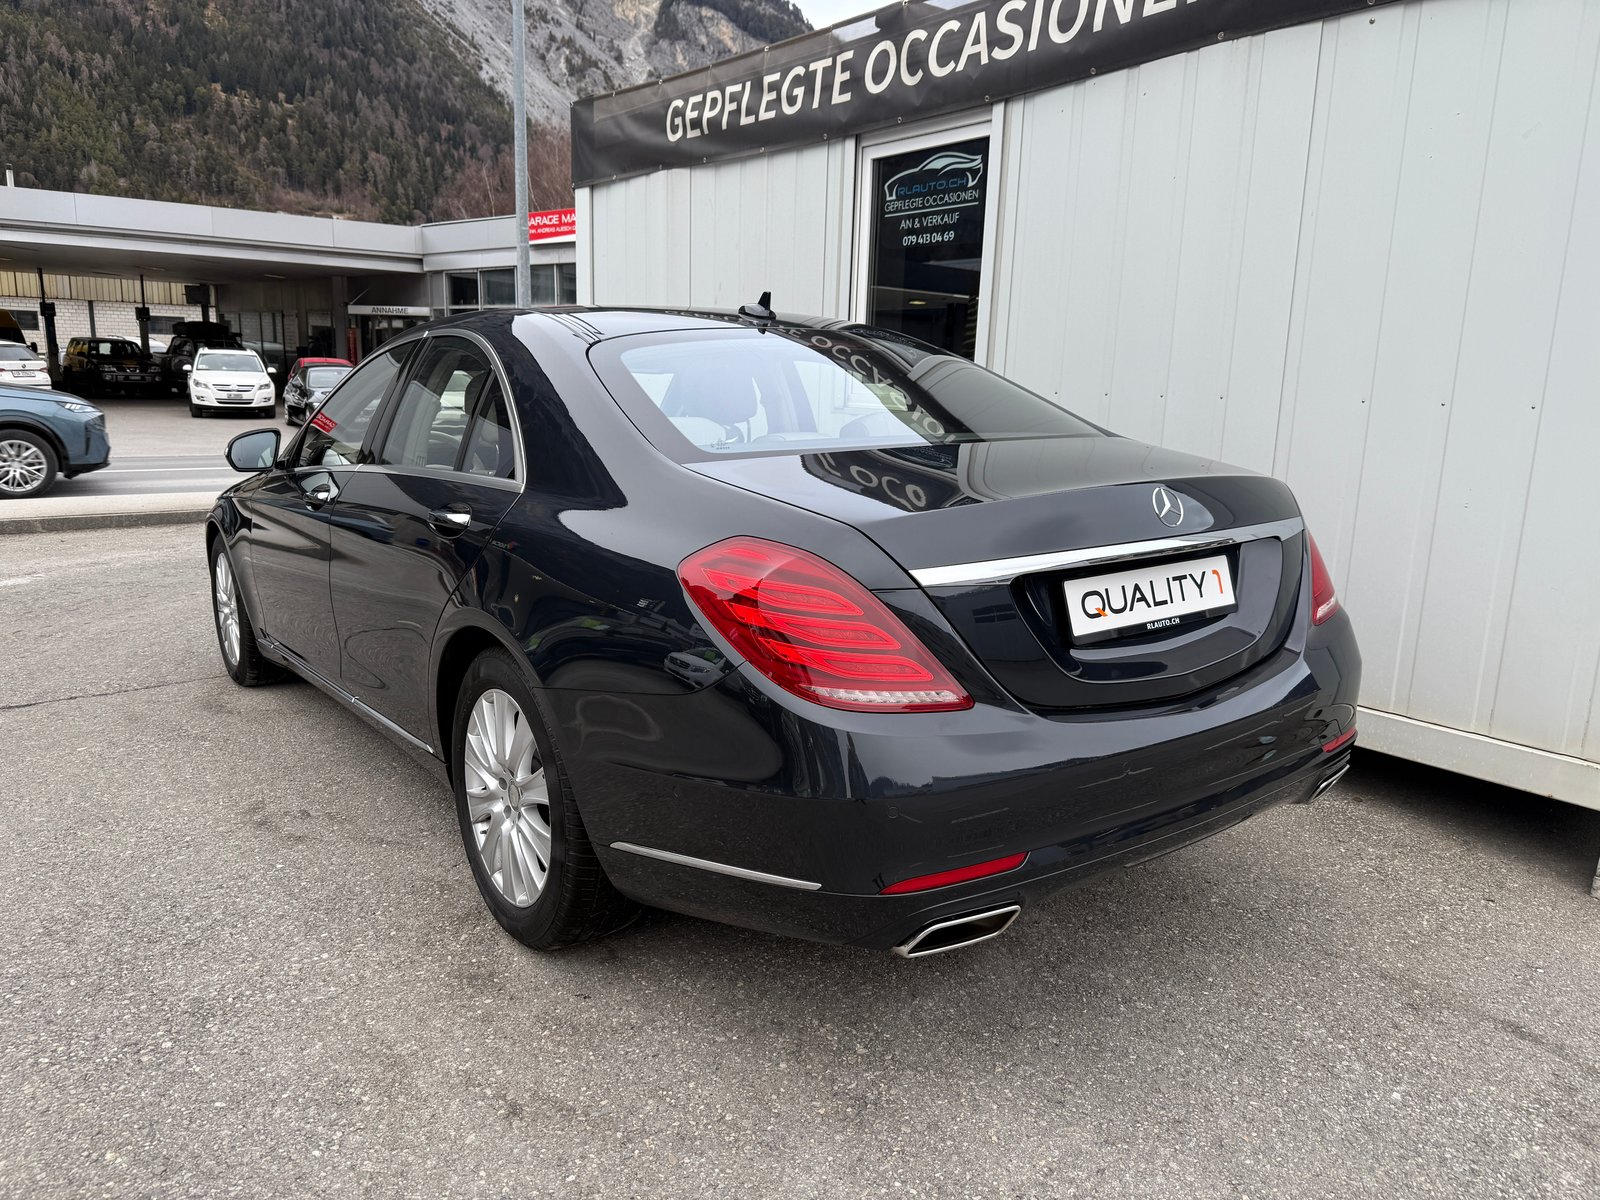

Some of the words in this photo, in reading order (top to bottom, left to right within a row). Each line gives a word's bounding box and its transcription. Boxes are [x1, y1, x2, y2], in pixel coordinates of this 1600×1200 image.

[666, 50, 854, 142] GEPFLEGTE
[864, 0, 1198, 94] OCCASIO
[897, 177, 967, 196] RLAUTO.CH
[884, 197, 923, 212] GEPFLEGTE
[924, 189, 979, 207] OCCASIONEN
[900, 218, 912, 230] AN
[914, 218, 920, 228] &
[922, 212, 960, 227] VERKAUF
[902, 235, 916, 246] 079
[918, 234, 930, 244] 413
[931, 233, 942, 243] 04
[943, 230, 955, 241] 69
[371, 306, 409, 315] ANNAHME
[1146, 617, 1180, 630] RLAUTO.CH
